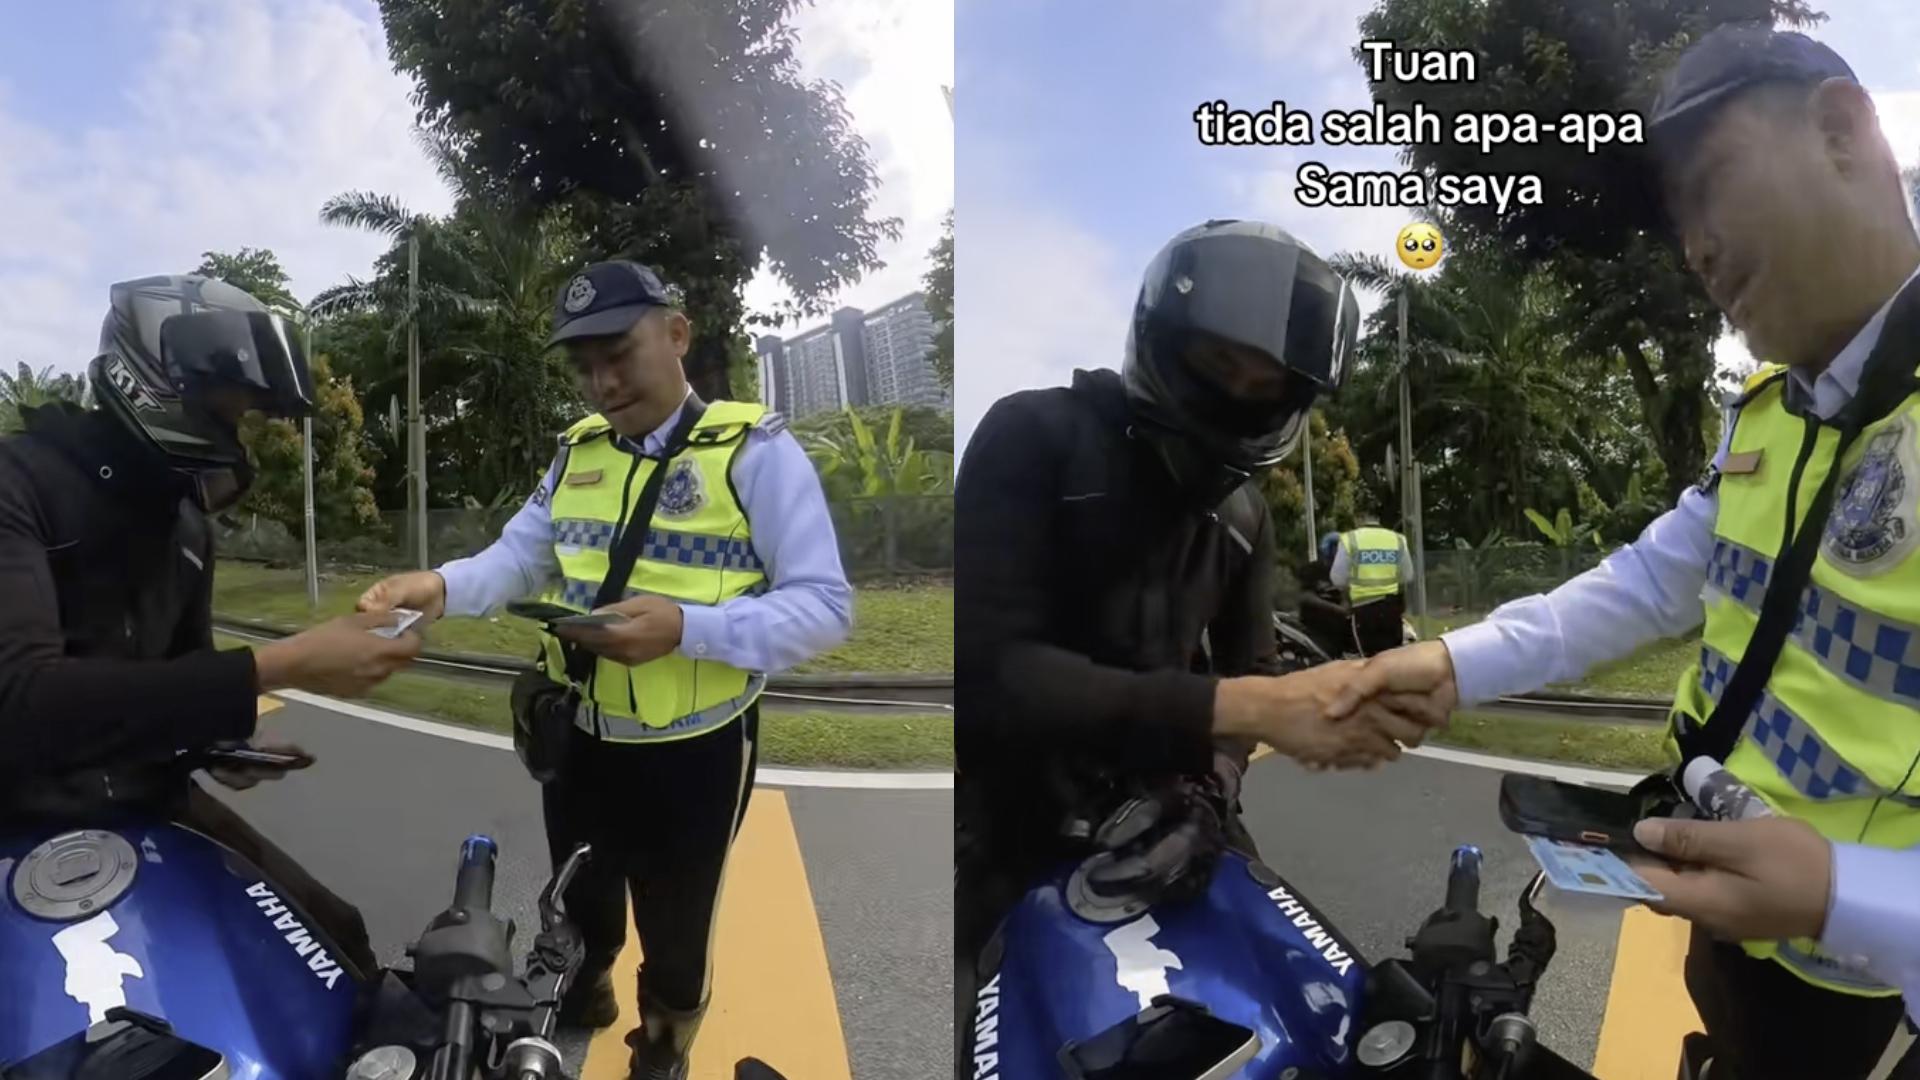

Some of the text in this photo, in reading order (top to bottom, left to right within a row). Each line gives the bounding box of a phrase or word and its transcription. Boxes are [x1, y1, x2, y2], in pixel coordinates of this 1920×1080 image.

[1361, 551, 1397, 563] POLIS
[245, 881, 344, 990] YAMAHA
[1267, 886, 1355, 977] YAMAHA
[974, 972, 1001, 1080] YAMA
